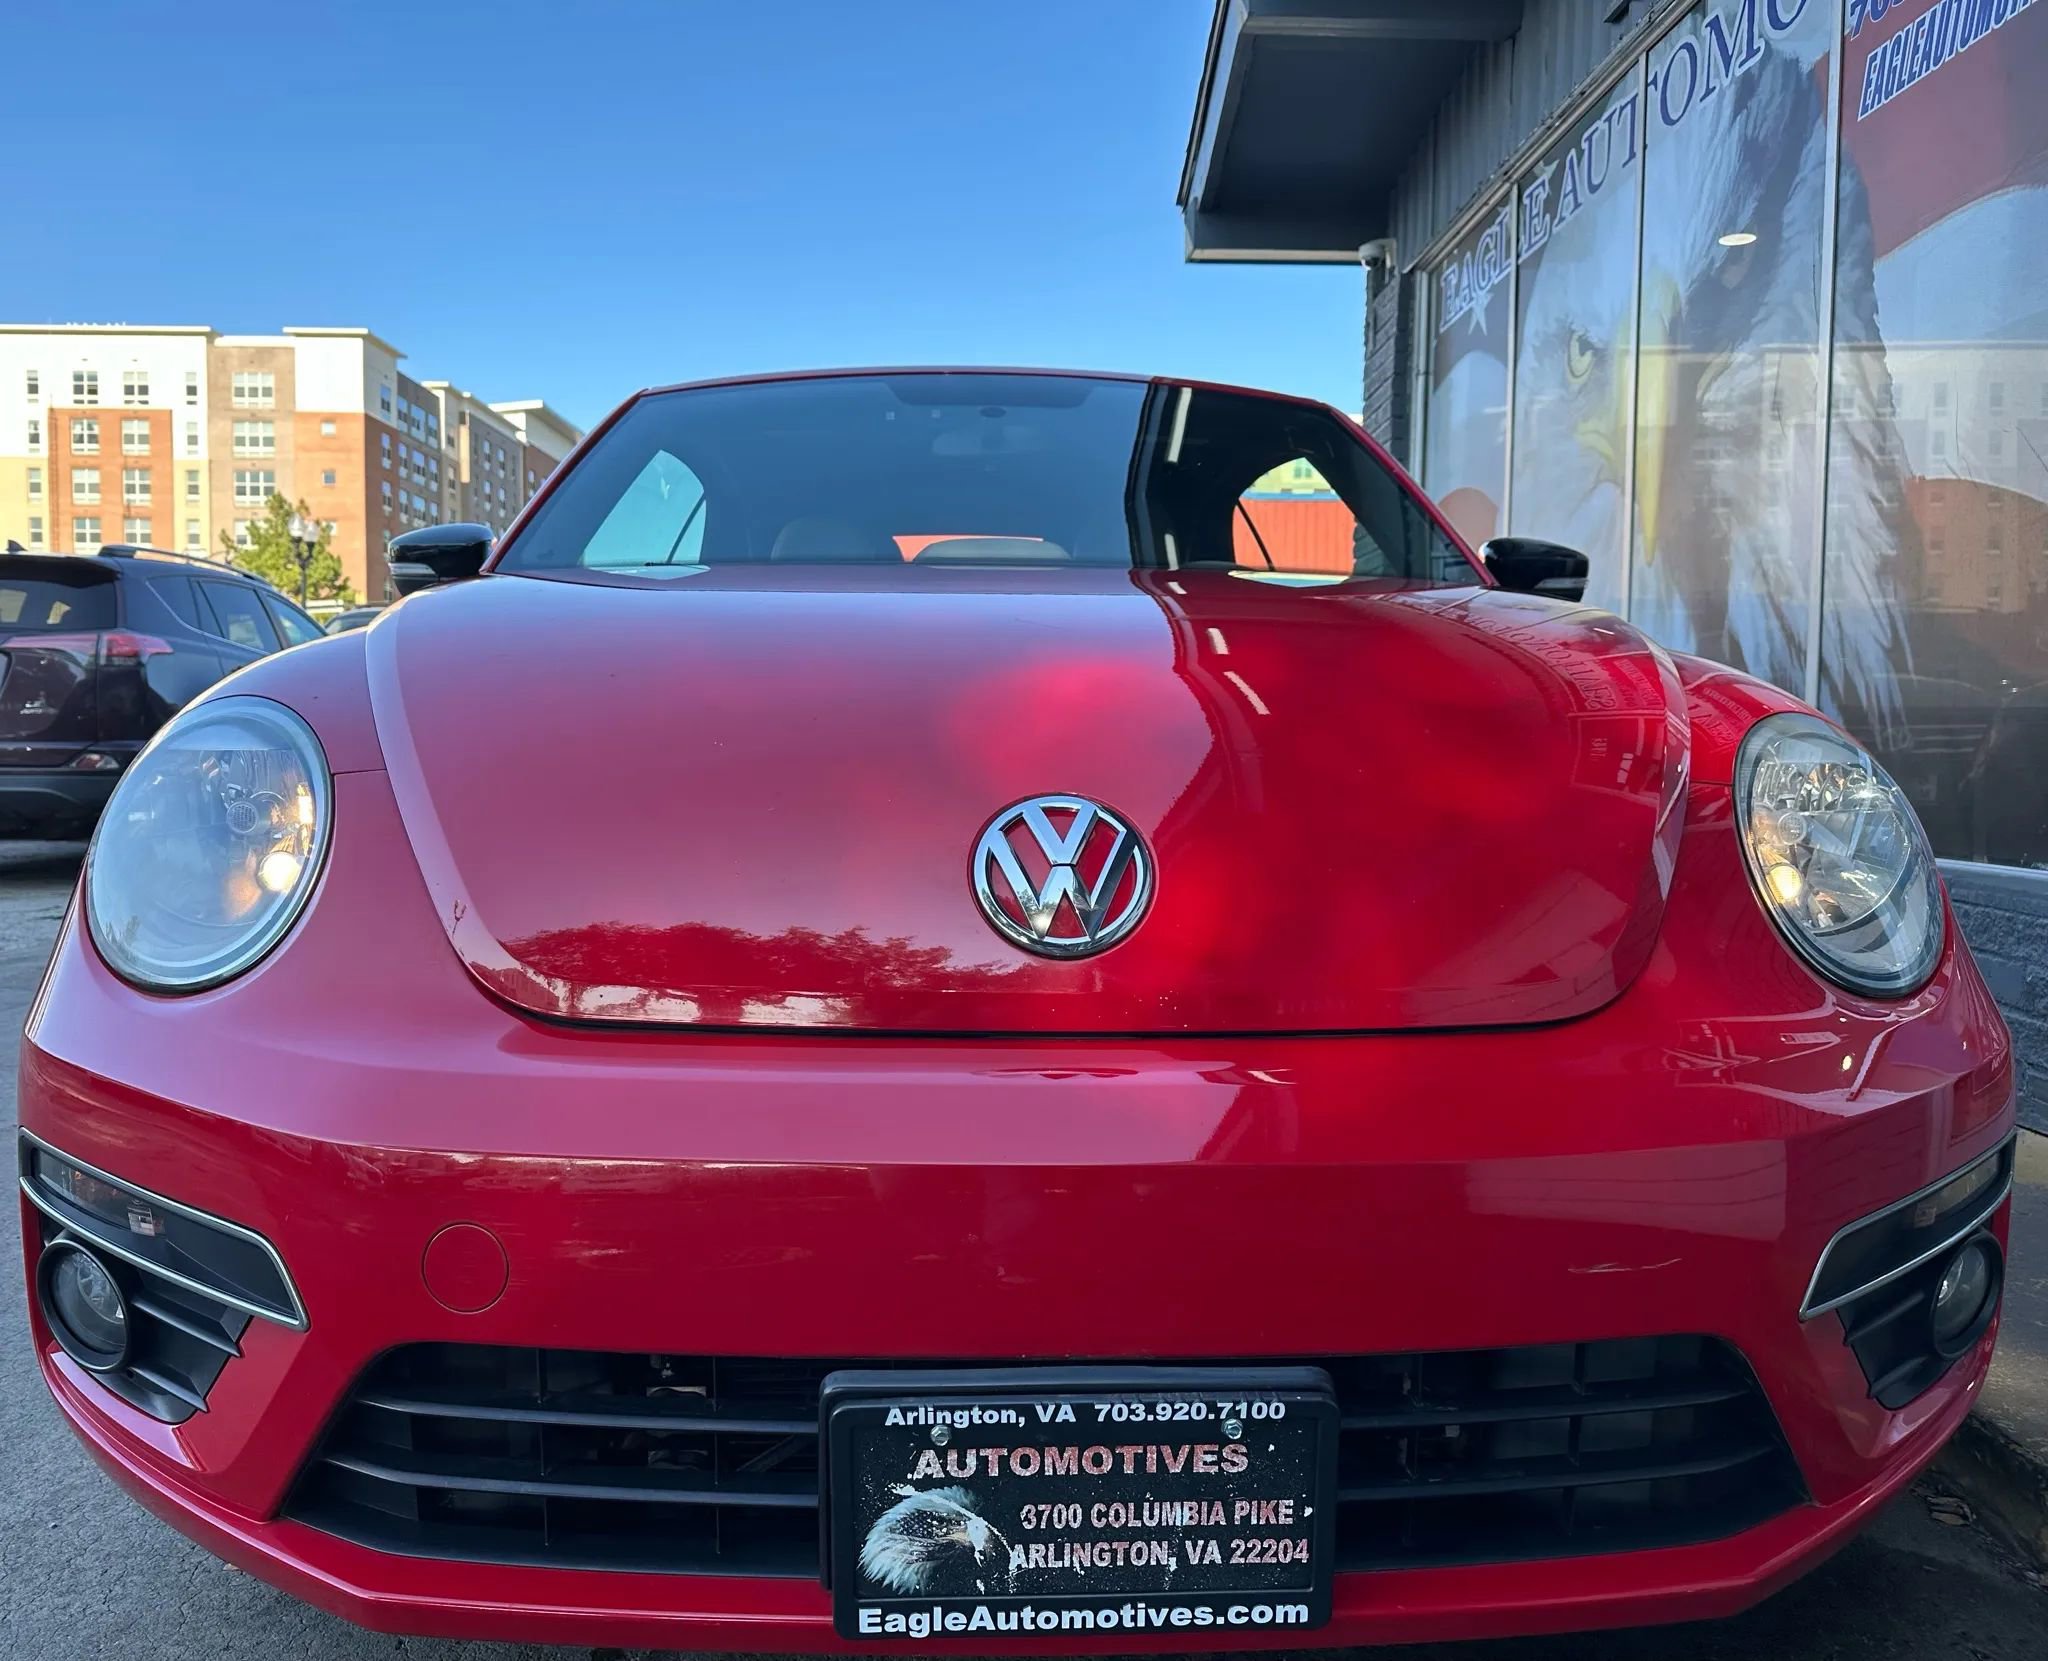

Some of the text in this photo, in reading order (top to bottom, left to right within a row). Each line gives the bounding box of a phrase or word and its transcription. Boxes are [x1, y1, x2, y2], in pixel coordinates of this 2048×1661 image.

[1439, 174, 1550, 334] EAGLE
[884, 1402, 1286, 1428] Arlington, VA 703.920.7100
[912, 1444, 1249, 1480] AUTOMOTIVES
[1020, 1500, 1294, 1529] 3700 COLUMBIA PIKE
[1009, 1538, 1309, 1572] ARLINGTON, VA 22204
[858, 1602, 1309, 1638] EagleAutomotives.com
